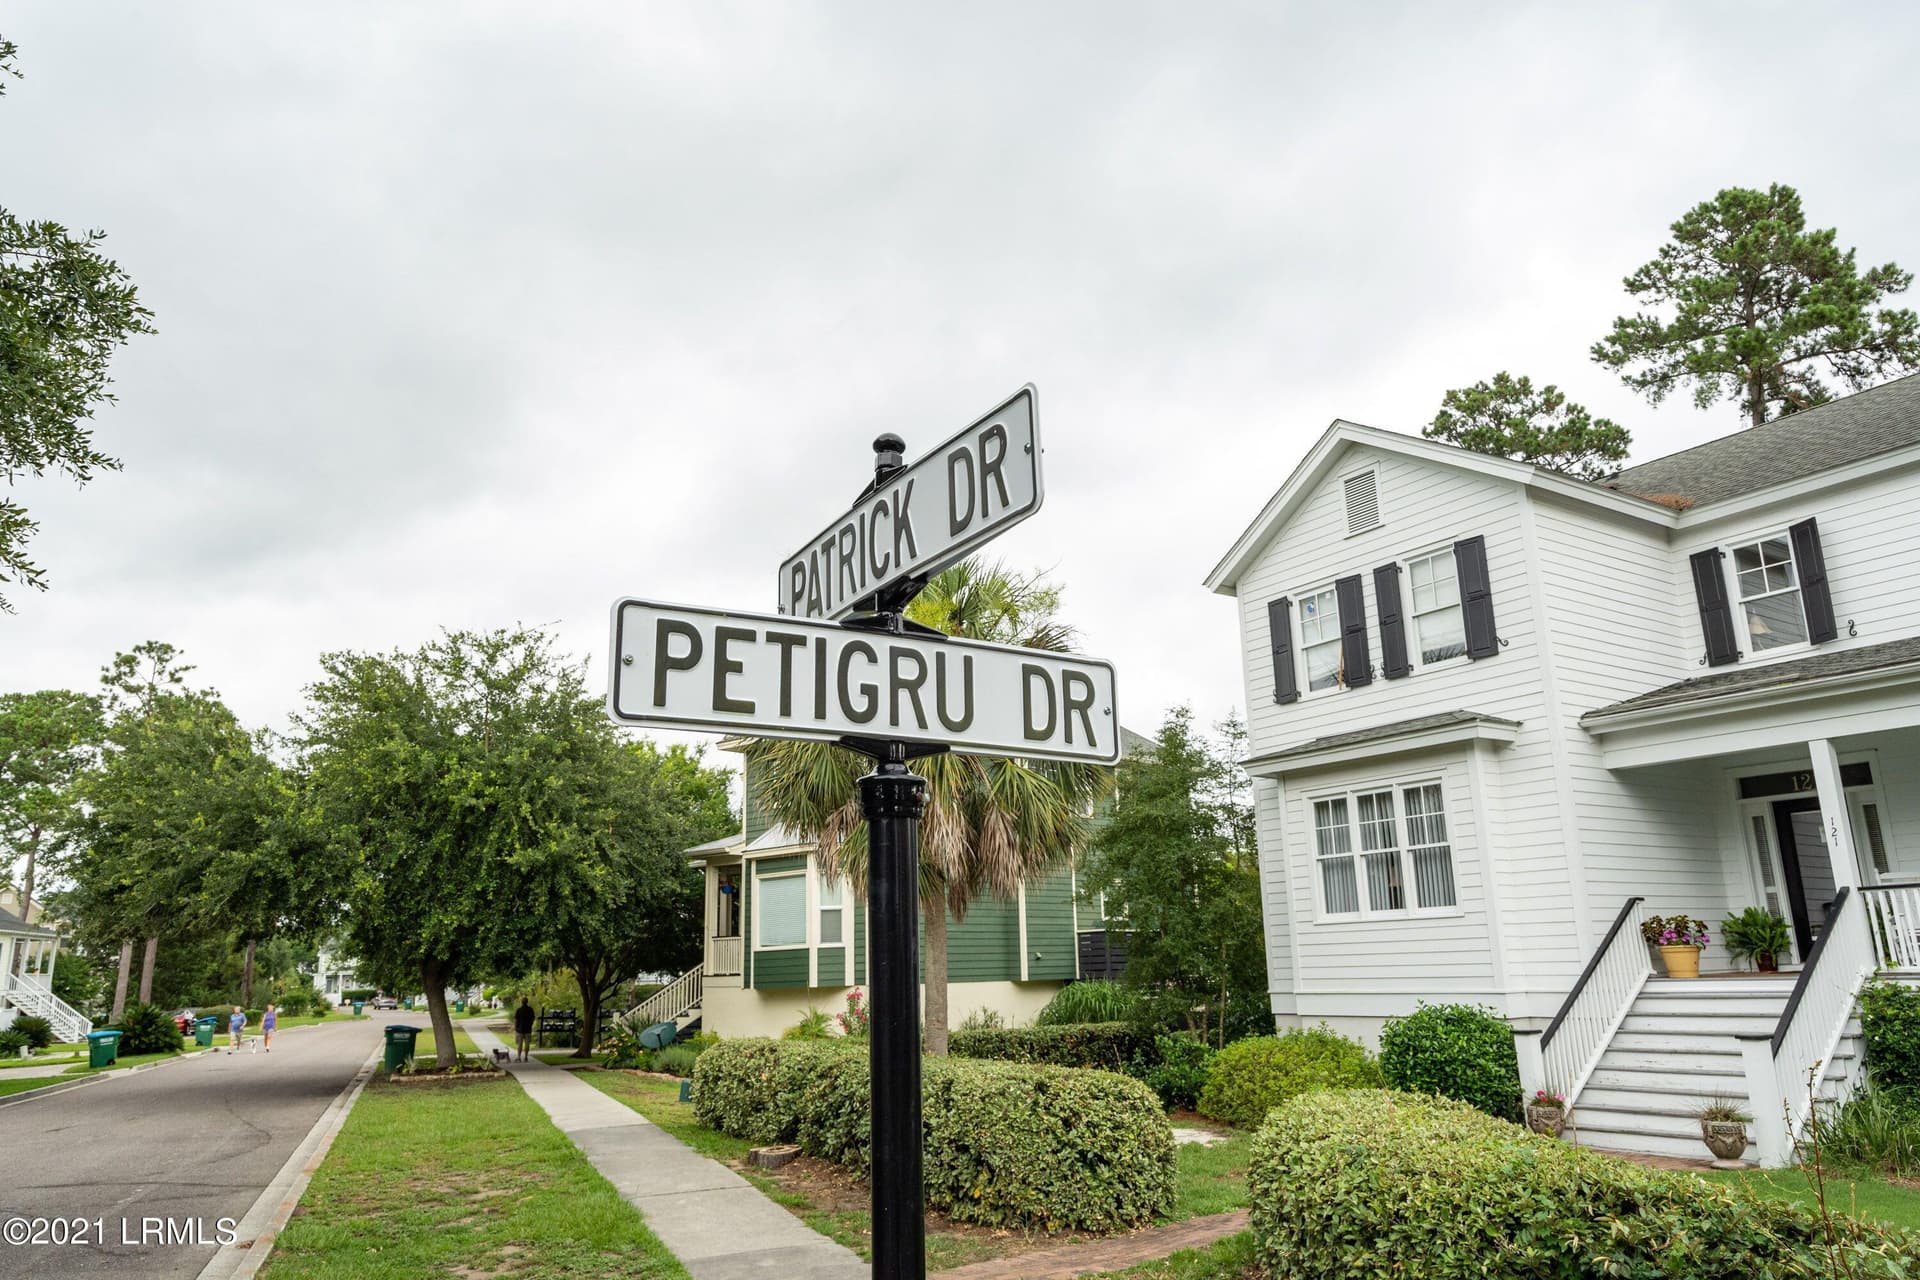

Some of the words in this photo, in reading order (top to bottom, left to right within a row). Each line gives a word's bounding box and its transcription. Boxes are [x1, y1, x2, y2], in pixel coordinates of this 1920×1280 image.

[791, 478, 918, 618] PATRICK
[948, 423, 1010, 537] DR
[653, 618, 973, 732] PETIGRU
[1022, 663, 1097, 747] DR
[1791, 773, 1813, 792] 12
[1830, 816, 1838, 847] 121
